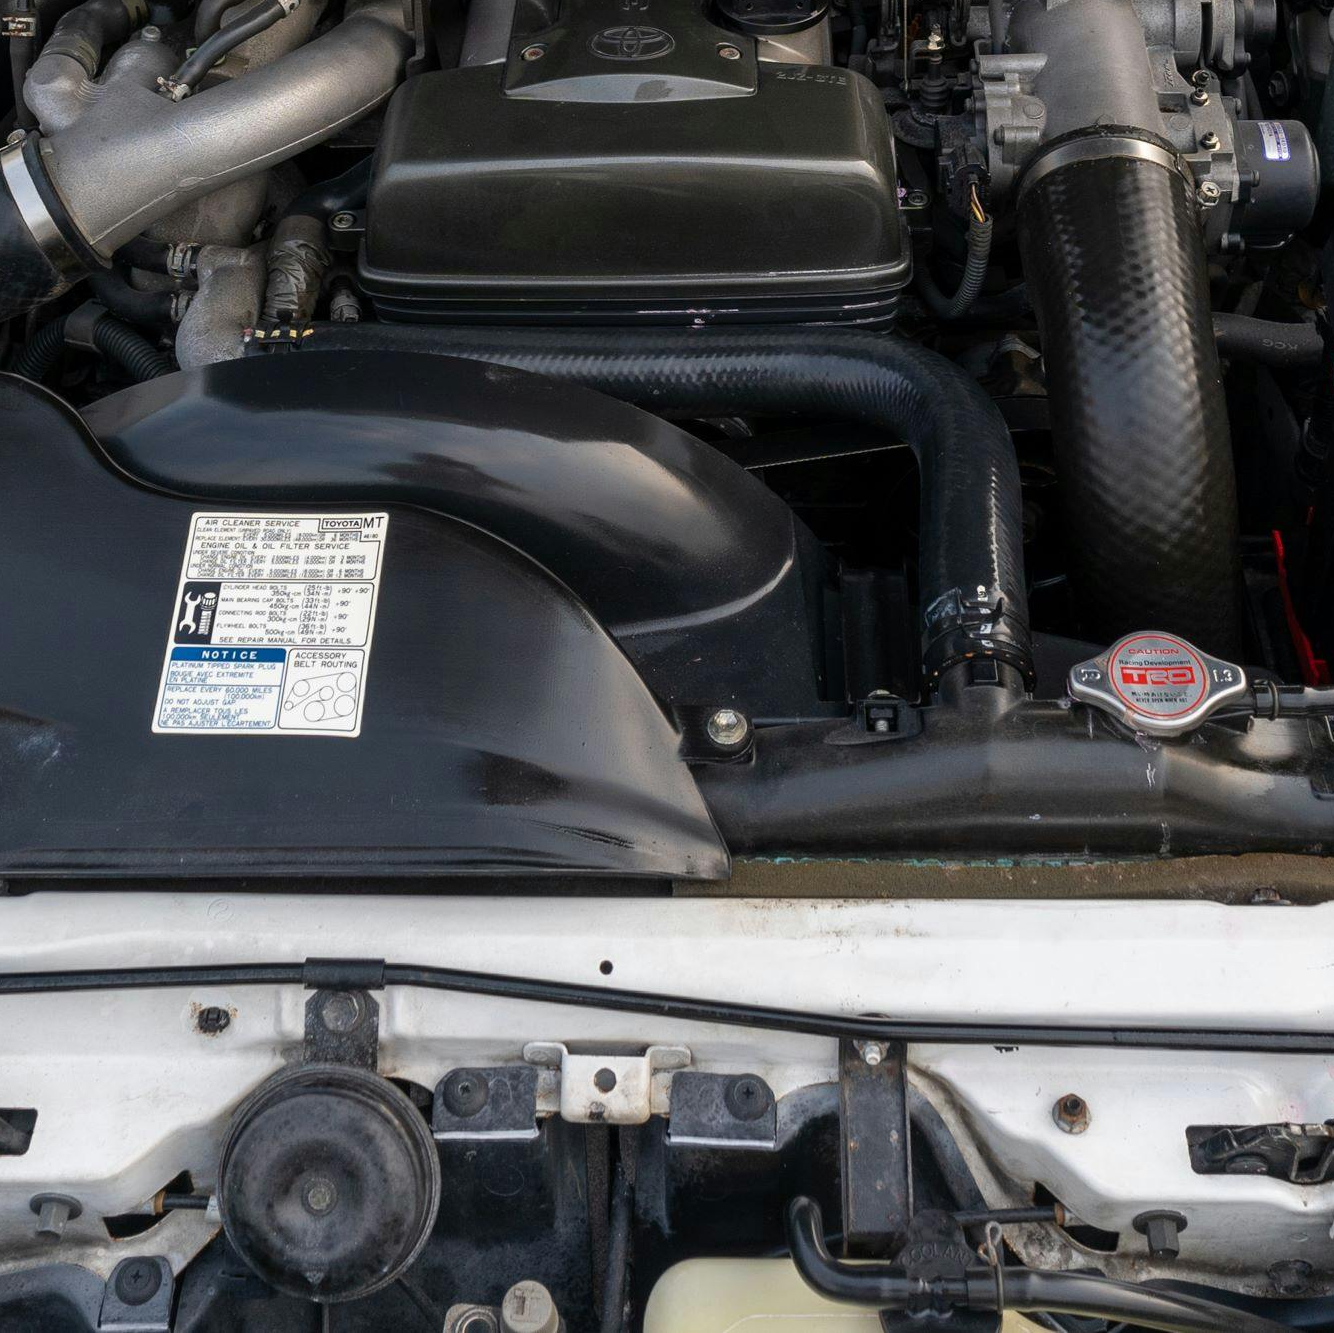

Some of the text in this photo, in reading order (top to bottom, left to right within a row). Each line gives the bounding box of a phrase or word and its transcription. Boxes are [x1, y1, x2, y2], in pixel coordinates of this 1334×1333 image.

[205, 519, 218, 527] AIR
[222, 519, 261, 527] CLEANER
[324, 516, 385, 529] TOYOTA MT
[202, 650, 258, 660] NOTICE
[295, 652, 347, 660] ACCESSORY
[1118, 659, 1192, 667] Racing Development
[1122, 669, 1193, 684] TRD
